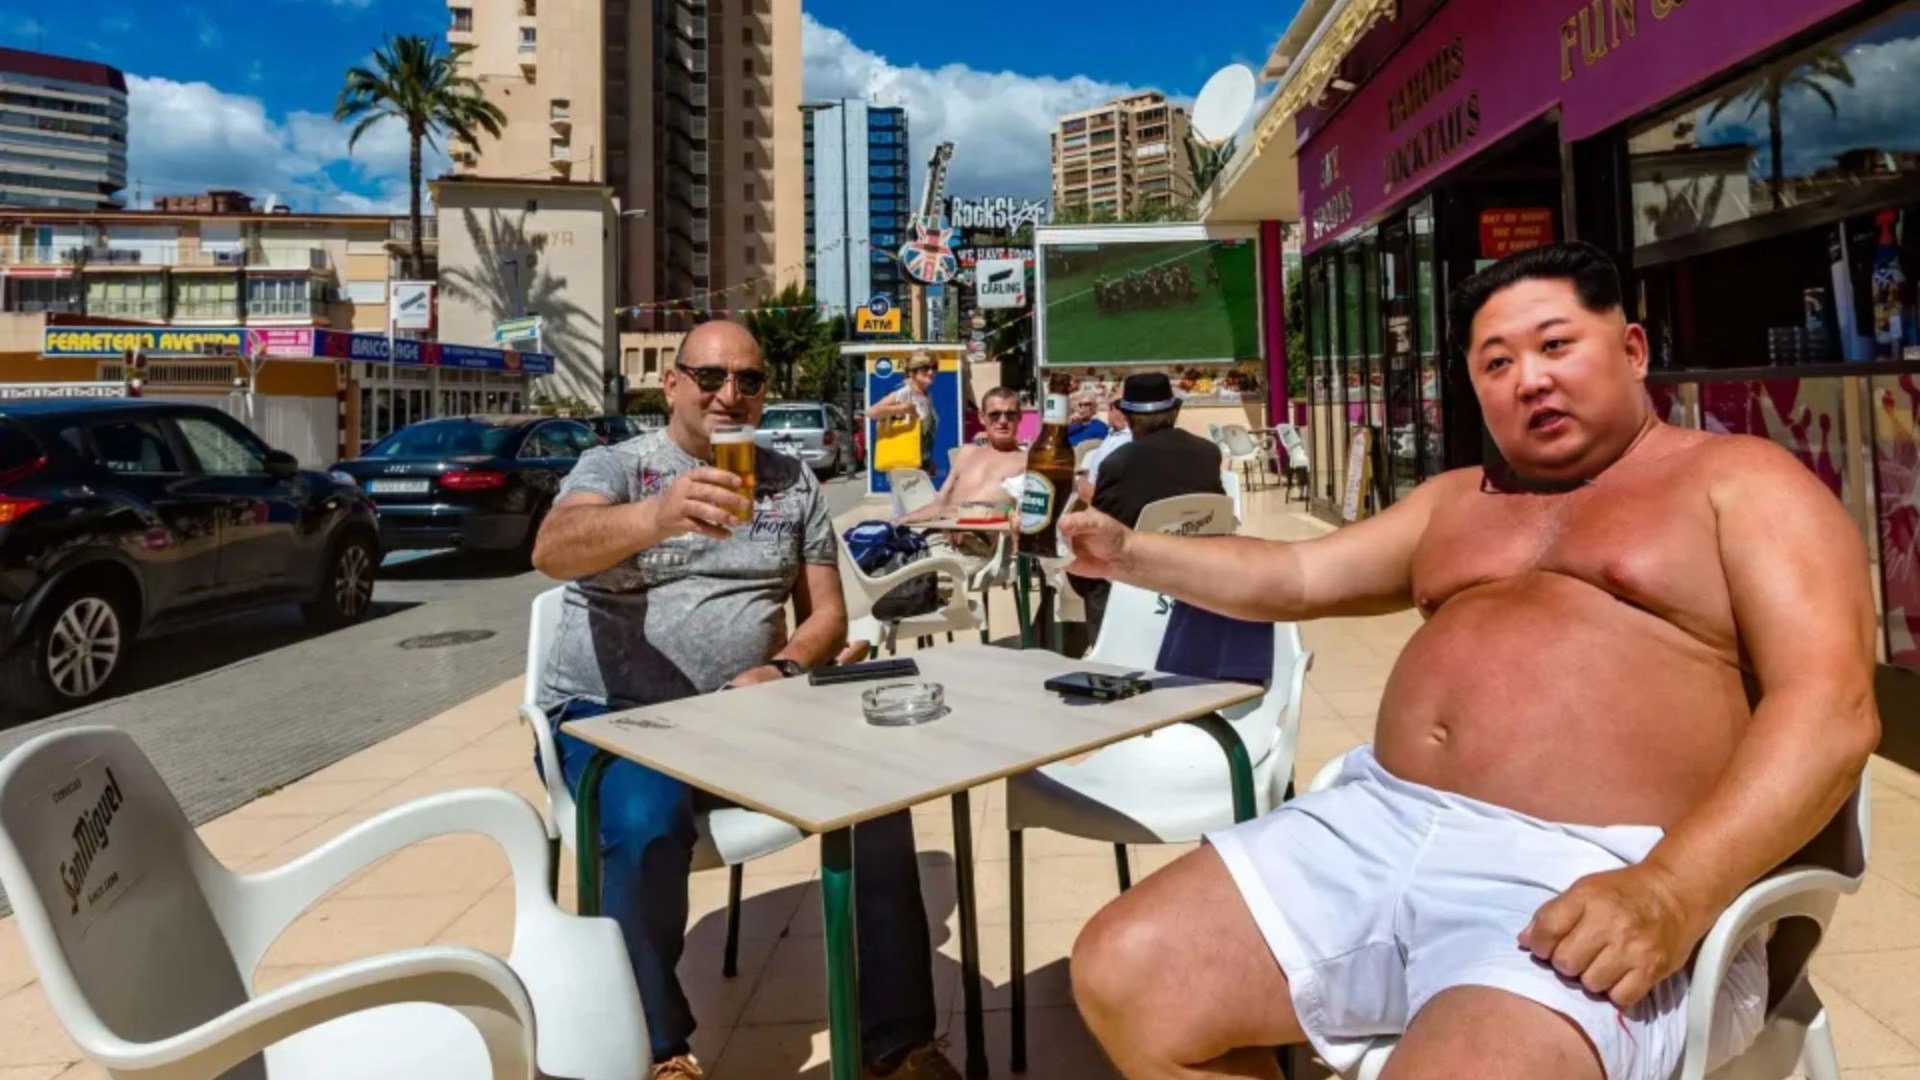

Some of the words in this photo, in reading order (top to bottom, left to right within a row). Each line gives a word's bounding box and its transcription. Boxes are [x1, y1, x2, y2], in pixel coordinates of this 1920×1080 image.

[1559, 0, 1636, 82] FUN
[981, 283, 1021, 294] CARLING
[863, 319, 893, 330] ATM
[352, 338, 419, 360] BRICOAGE
